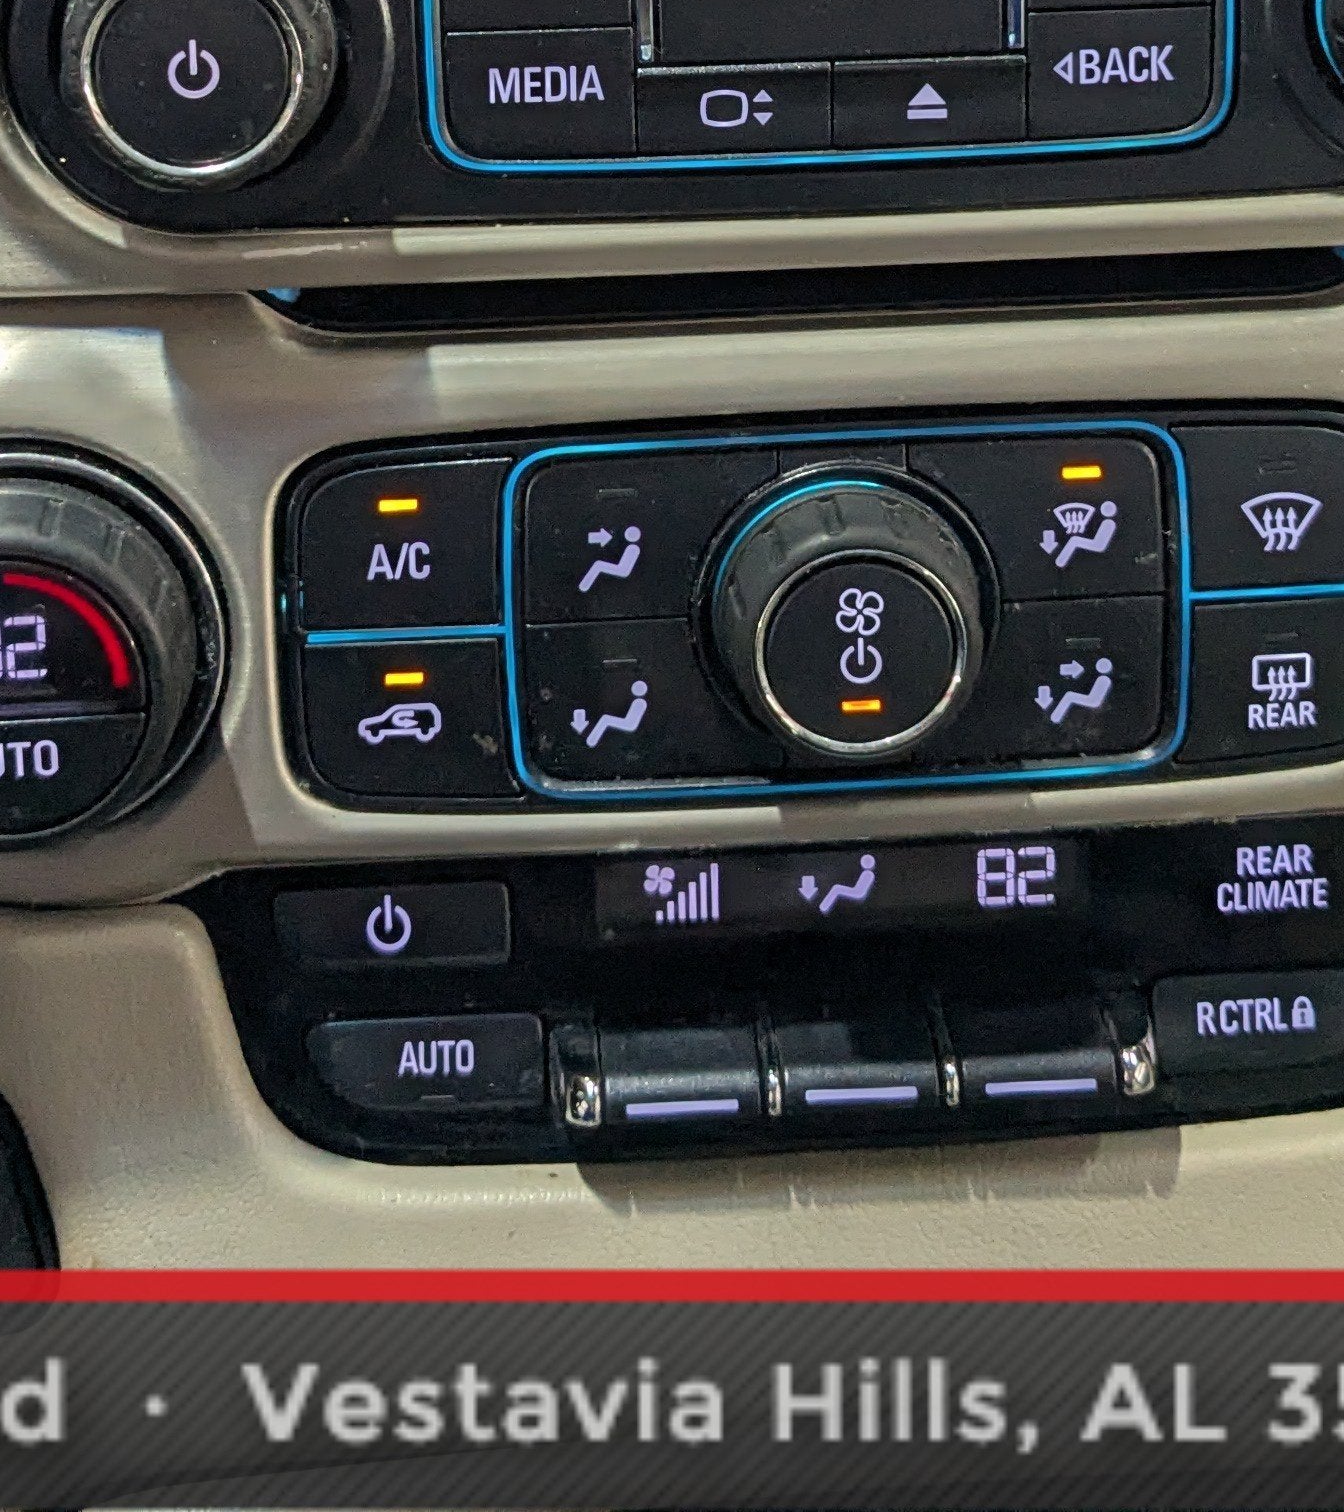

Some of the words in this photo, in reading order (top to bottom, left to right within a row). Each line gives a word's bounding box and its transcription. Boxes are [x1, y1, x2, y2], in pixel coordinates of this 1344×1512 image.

[1079, 44, 1174, 85] BACK
[488, 64, 605, 104] MEDIA
[367, 541, 431, 581] A/C
[1247, 702, 1317, 730] REAR
[976, 846, 1056, 906] 82
[1235, 844, 1314, 878] REAR
[1216, 877, 1328, 912] CLIMATE
[398, 1039, 475, 1075] AUTO
